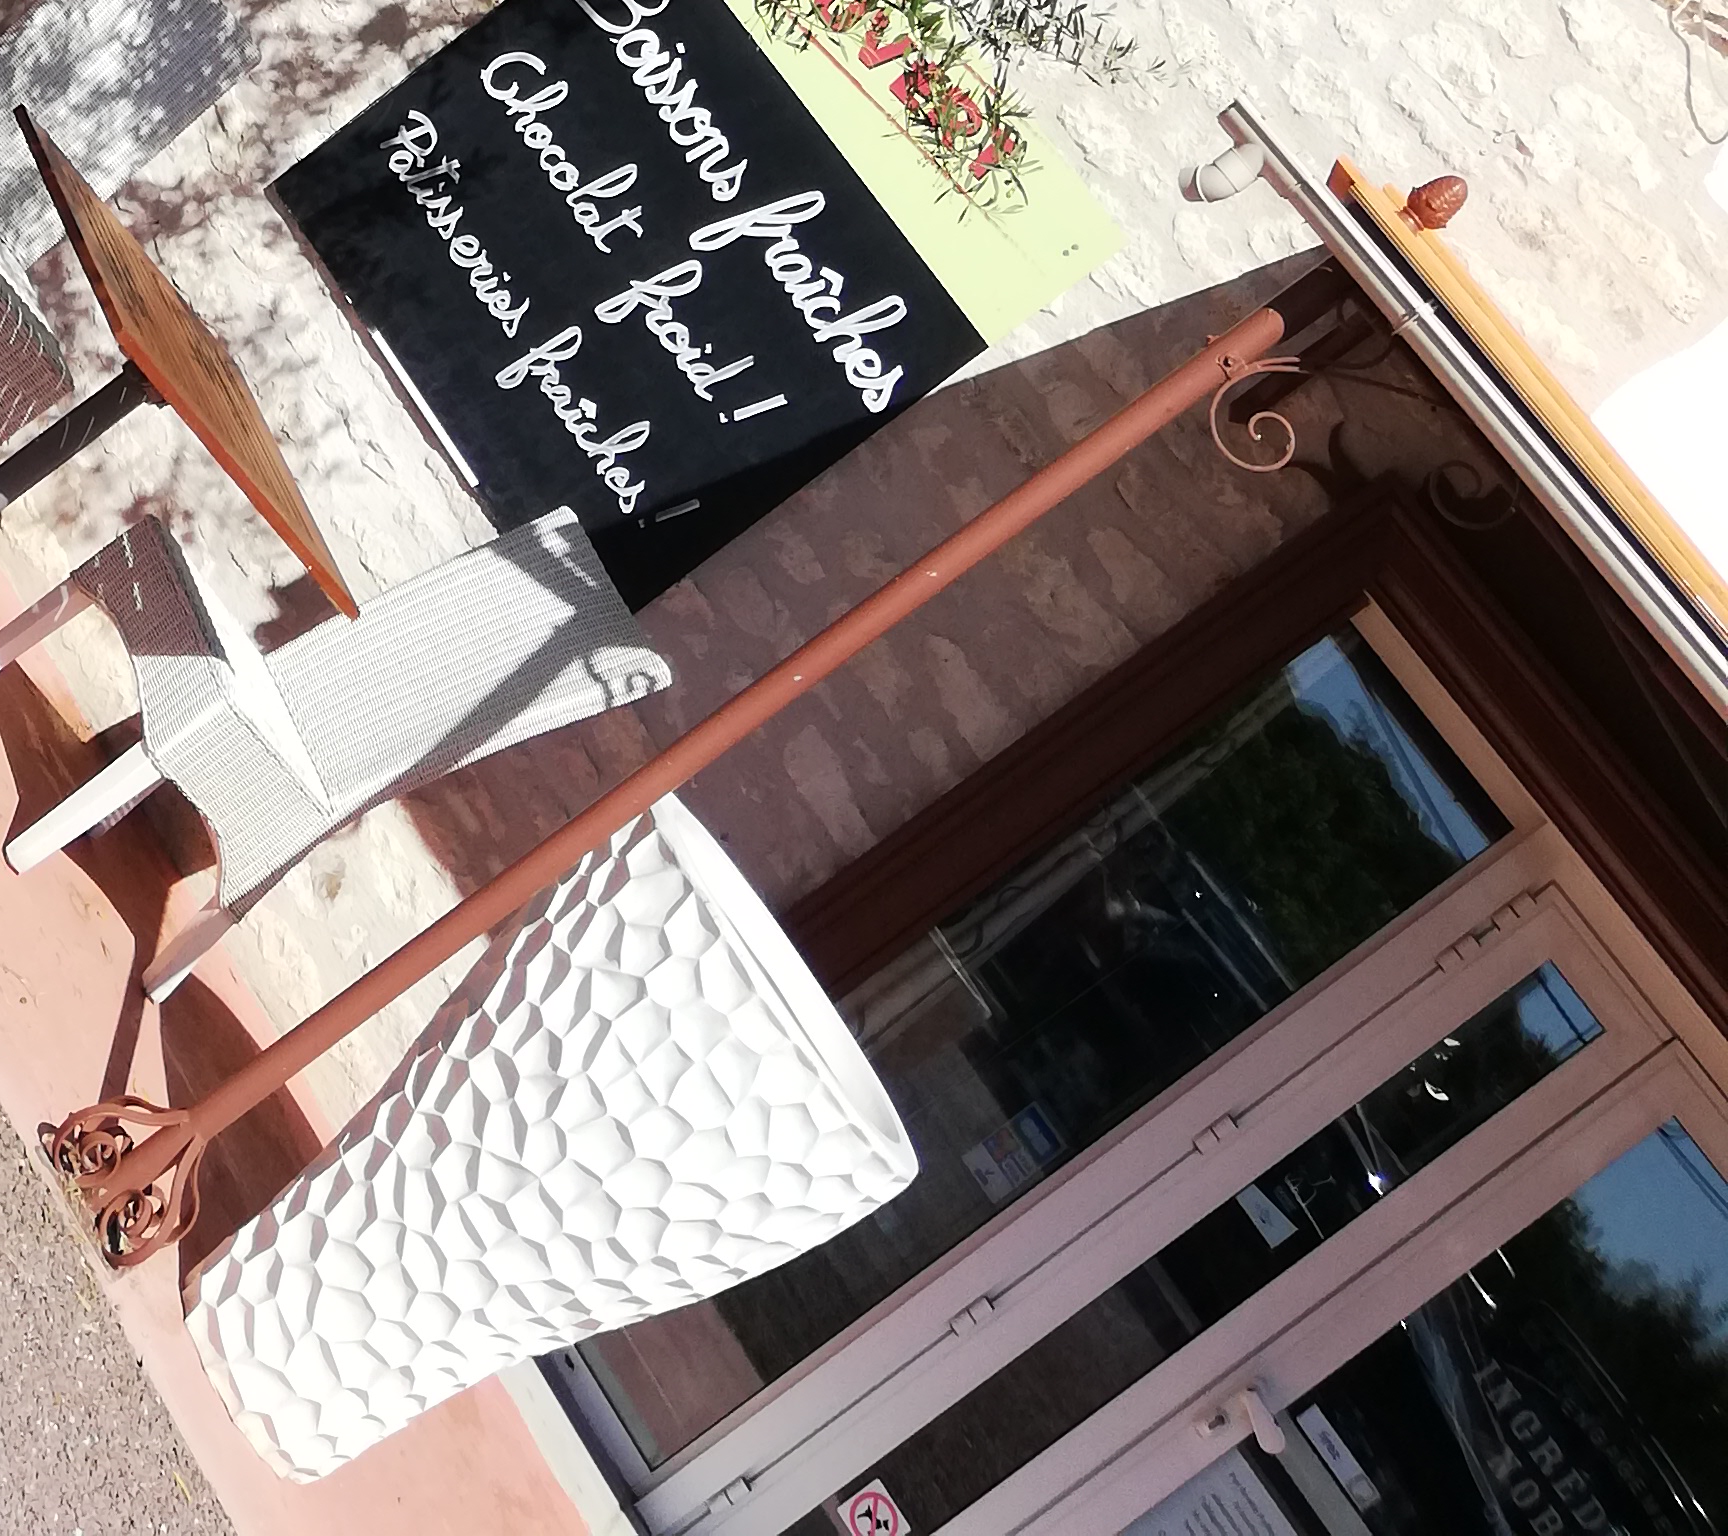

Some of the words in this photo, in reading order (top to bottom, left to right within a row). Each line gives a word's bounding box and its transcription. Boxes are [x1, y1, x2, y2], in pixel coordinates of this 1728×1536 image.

[479, 51, 644, 254] Chocolat
[593, 258, 755, 402] froid
[688, 189, 908, 414] fraîches
[494, 325, 651, 515] fraîches
